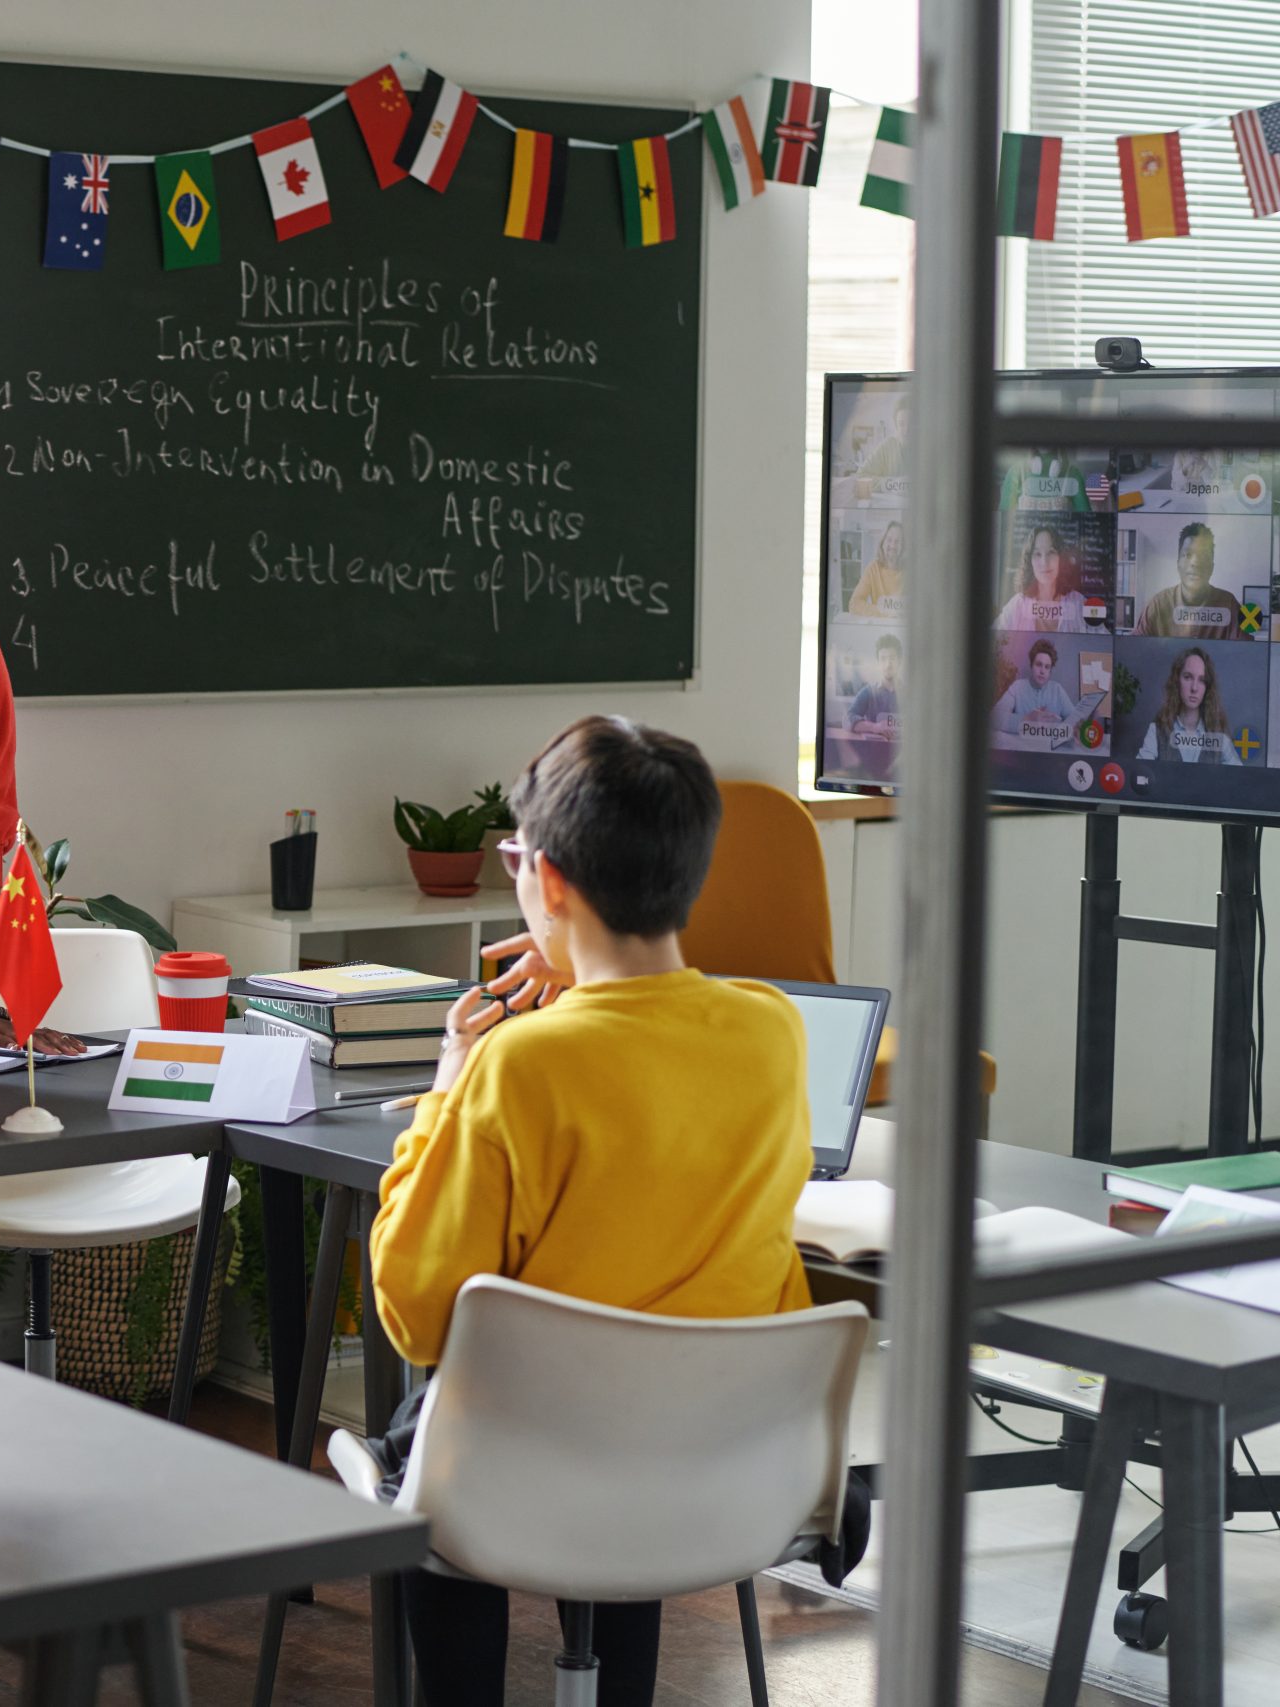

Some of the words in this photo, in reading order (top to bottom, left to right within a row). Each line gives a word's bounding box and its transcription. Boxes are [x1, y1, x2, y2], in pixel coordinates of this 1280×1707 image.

[240, 257, 442, 327] Principles
[460, 276, 498, 331] of
[442, 321, 598, 369] Relations
[208, 369, 380, 451] Equality
[4, 443, 24, 476] 2
[361, 451, 395, 486] in
[409, 431, 573, 491] Domestic
[1038, 479, 1062, 493] USA
[1185, 482, 1220, 498] Japan
[442, 491, 585, 550] Affairs
[50, 538, 221, 616] Peaceful
[248, 529, 457, 597] Settlement
[473, 553, 504, 633] of
[522, 550, 670, 624] Disputes
[1031, 603, 1064, 620] Egypt
[1177, 609, 1224, 624] Jamaica
[11, 614, 39, 671] 4
[1022, 723, 1070, 740] Portugal
[1173, 732, 1220, 749] Sweden
